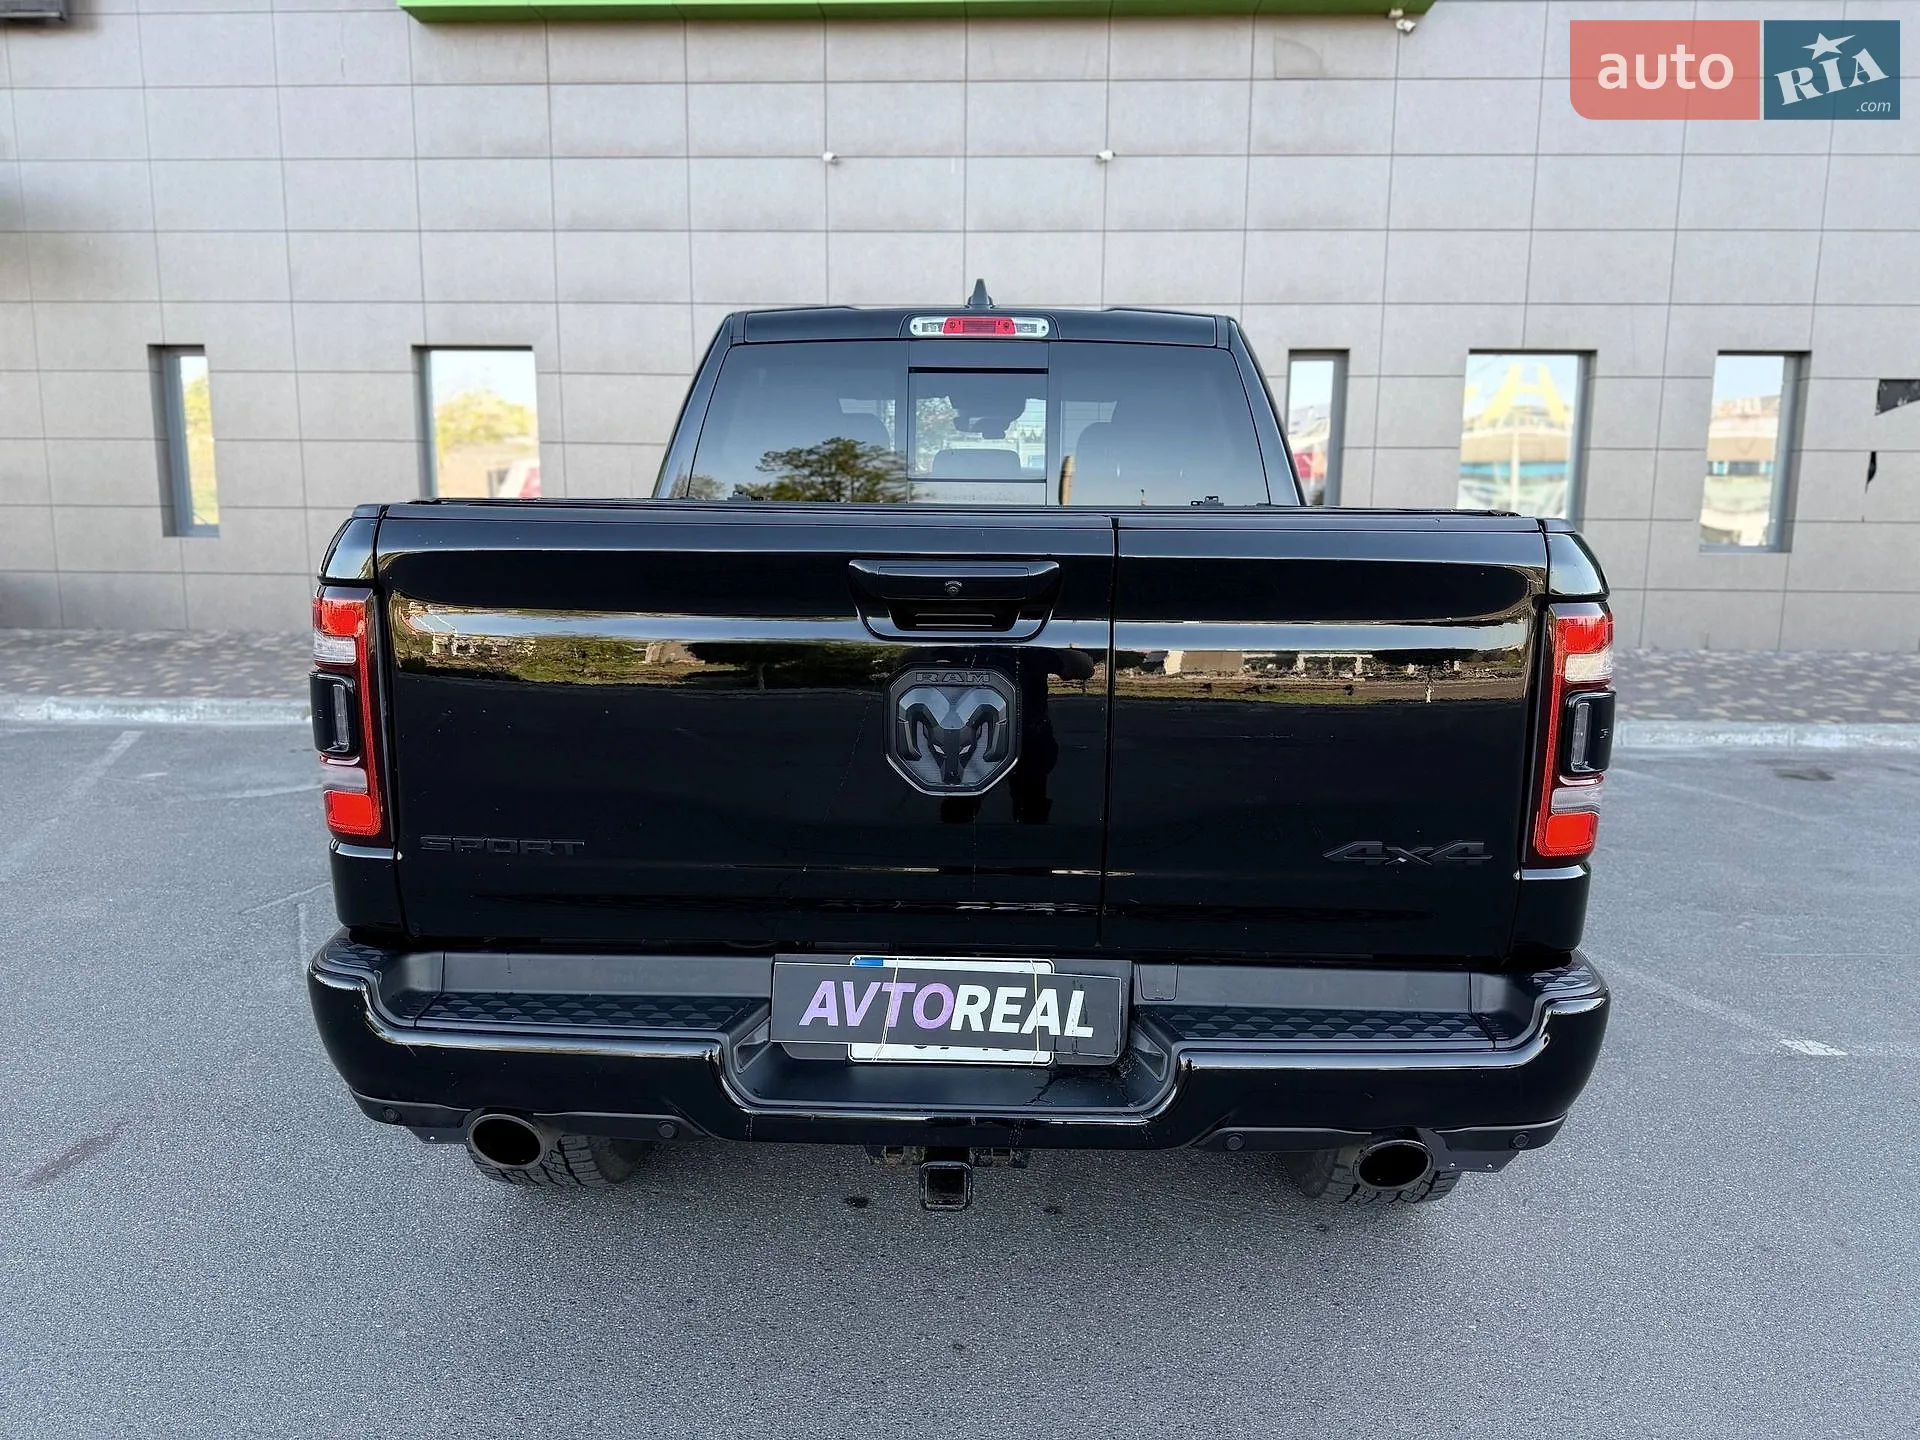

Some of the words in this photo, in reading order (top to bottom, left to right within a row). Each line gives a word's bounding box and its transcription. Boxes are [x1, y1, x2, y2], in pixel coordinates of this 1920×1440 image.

[915, 672, 990, 683] RAM
[420, 835, 585, 855] SPORT
[799, 980, 1094, 1038] AVTOREAL
